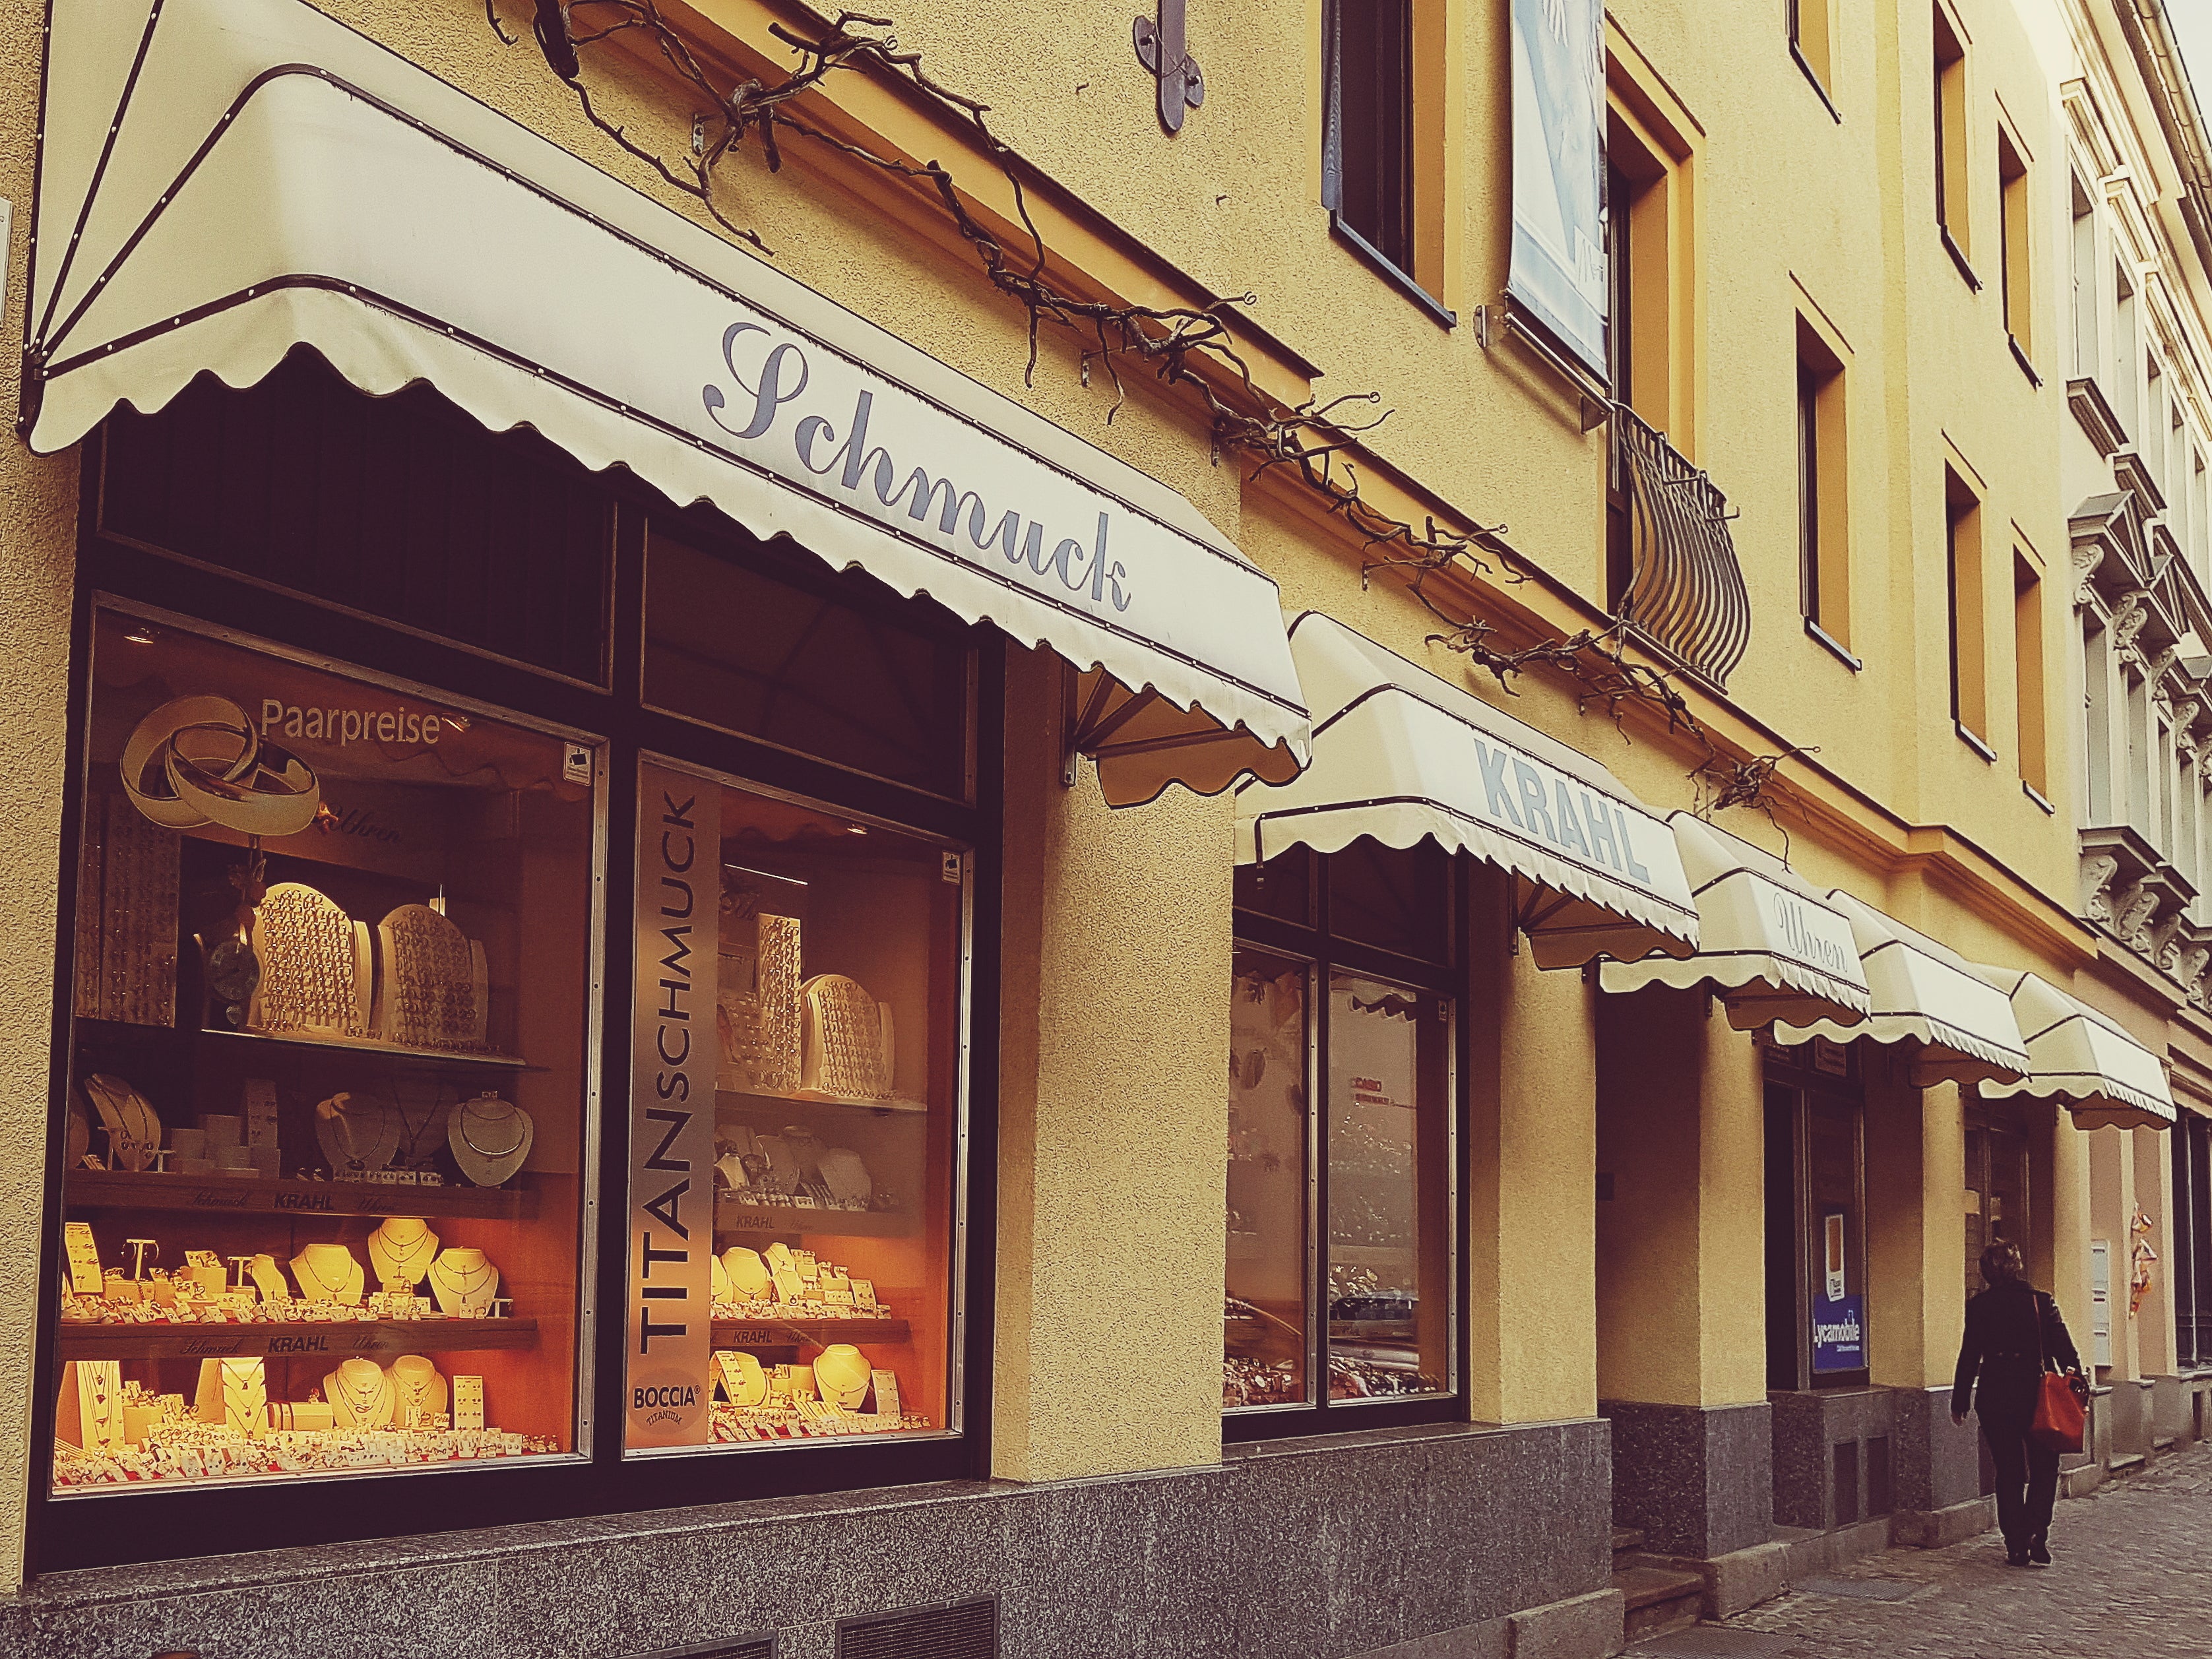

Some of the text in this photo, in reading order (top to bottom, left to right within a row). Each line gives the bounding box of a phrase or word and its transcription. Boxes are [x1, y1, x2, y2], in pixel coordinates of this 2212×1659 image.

[702, 322, 1131, 612] Schmuck
[262, 699, 440, 747] Paarpreise
[1474, 737, 1651, 885] KRAHL
[1773, 892, 1848, 973] Uhren
[641, 791, 697, 1354] TITANSCHMUCK
[273, 1192, 334, 1210] KRAHL
[736, 1215, 775, 1229] KRAHL
[268, 1335, 329, 1352] KRAHL
[733, 1330, 773, 1344] KRAHL
[646, 1410, 683, 1426] TITANIUM
